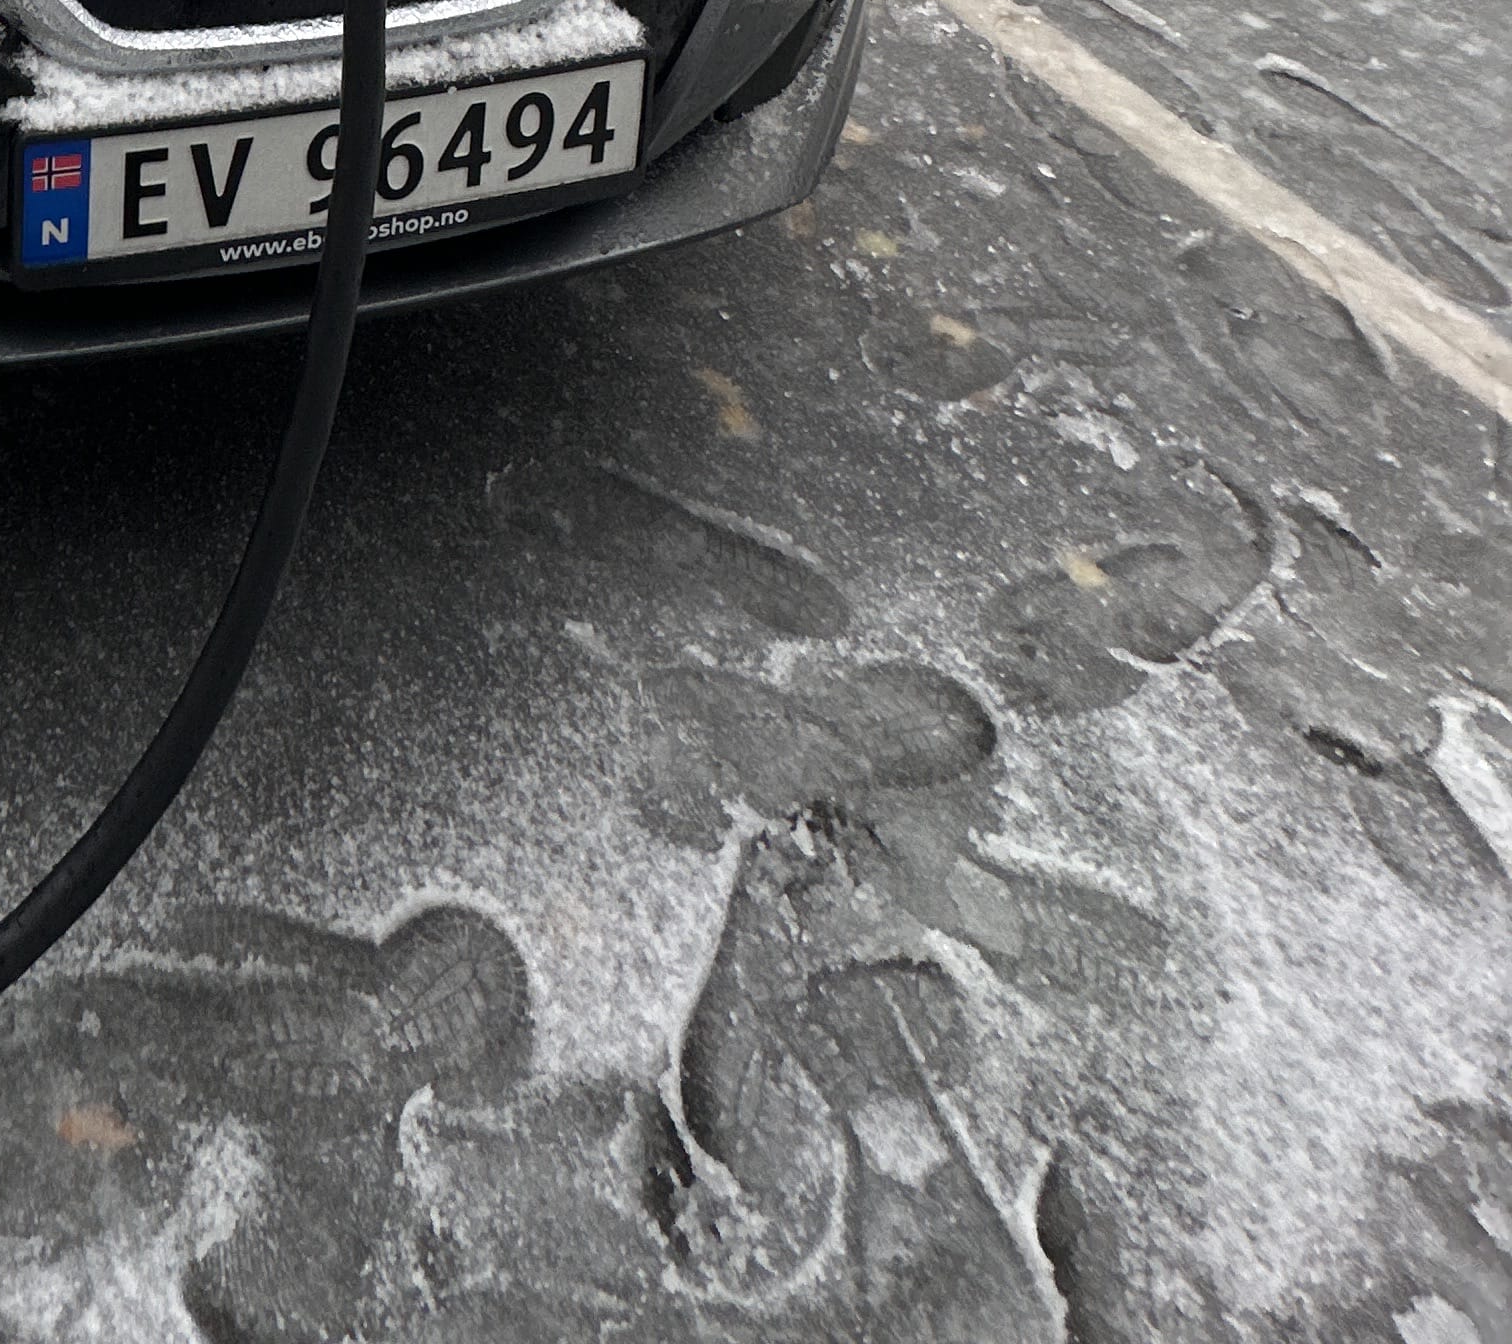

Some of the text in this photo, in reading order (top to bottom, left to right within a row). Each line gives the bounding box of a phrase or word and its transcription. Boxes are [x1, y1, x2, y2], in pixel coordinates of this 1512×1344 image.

[122, 80, 616, 240] EV 96494
[41, 219, 70, 246] N
